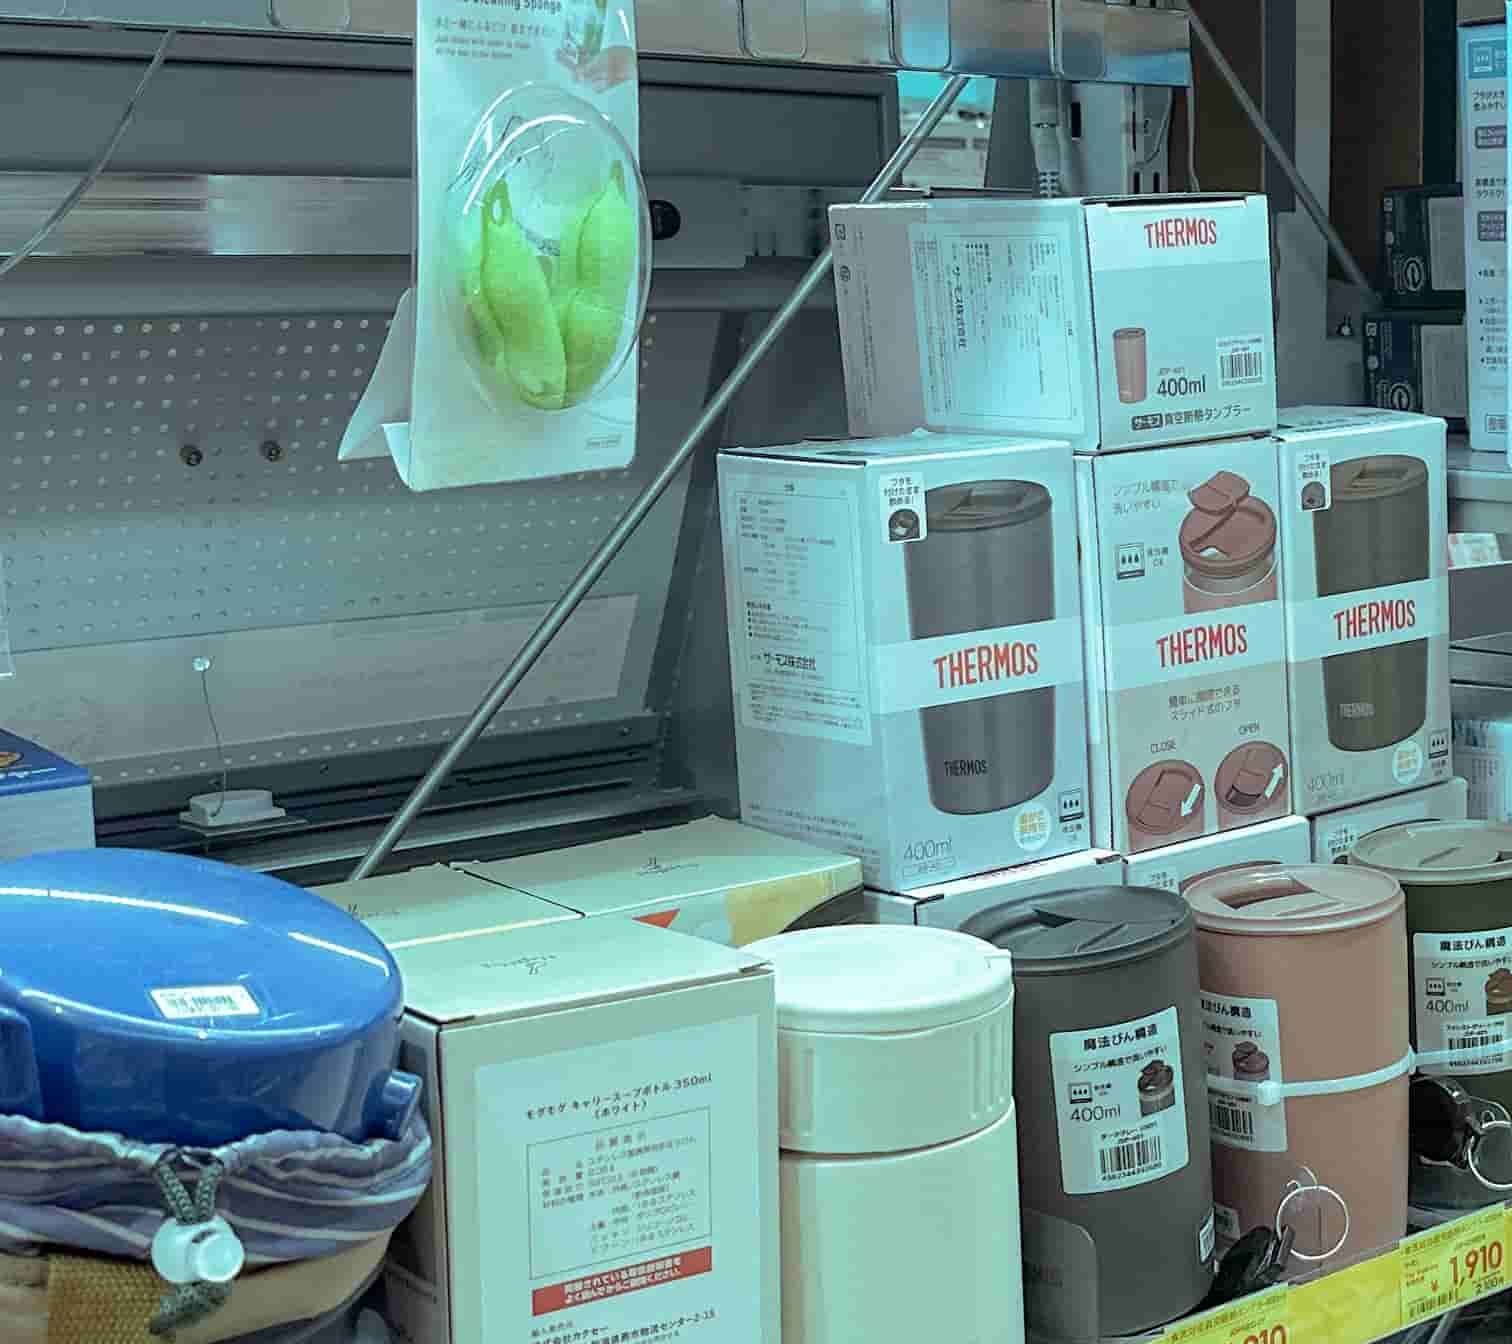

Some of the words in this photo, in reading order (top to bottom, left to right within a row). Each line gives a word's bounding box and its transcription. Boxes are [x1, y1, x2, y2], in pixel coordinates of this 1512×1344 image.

[1144, 217, 1217, 249] THERMOS
[1157, 373, 1206, 397] 400ml
[1333, 599, 1417, 642] THERMOS
[1156, 623, 1248, 669] THERMOS
[932, 641, 1039, 690] THERMOS
[943, 759, 988, 777] THERMOS
[1440, 936, 1507, 952] 魔法びん構造
[1425, 999, 1471, 1015] 400ml
[1083, 1023, 1158, 1051] 魔法びん構造
[1069, 1104, 1122, 1124] 400ml
[1448, 1239, 1503, 1287] 1,910
